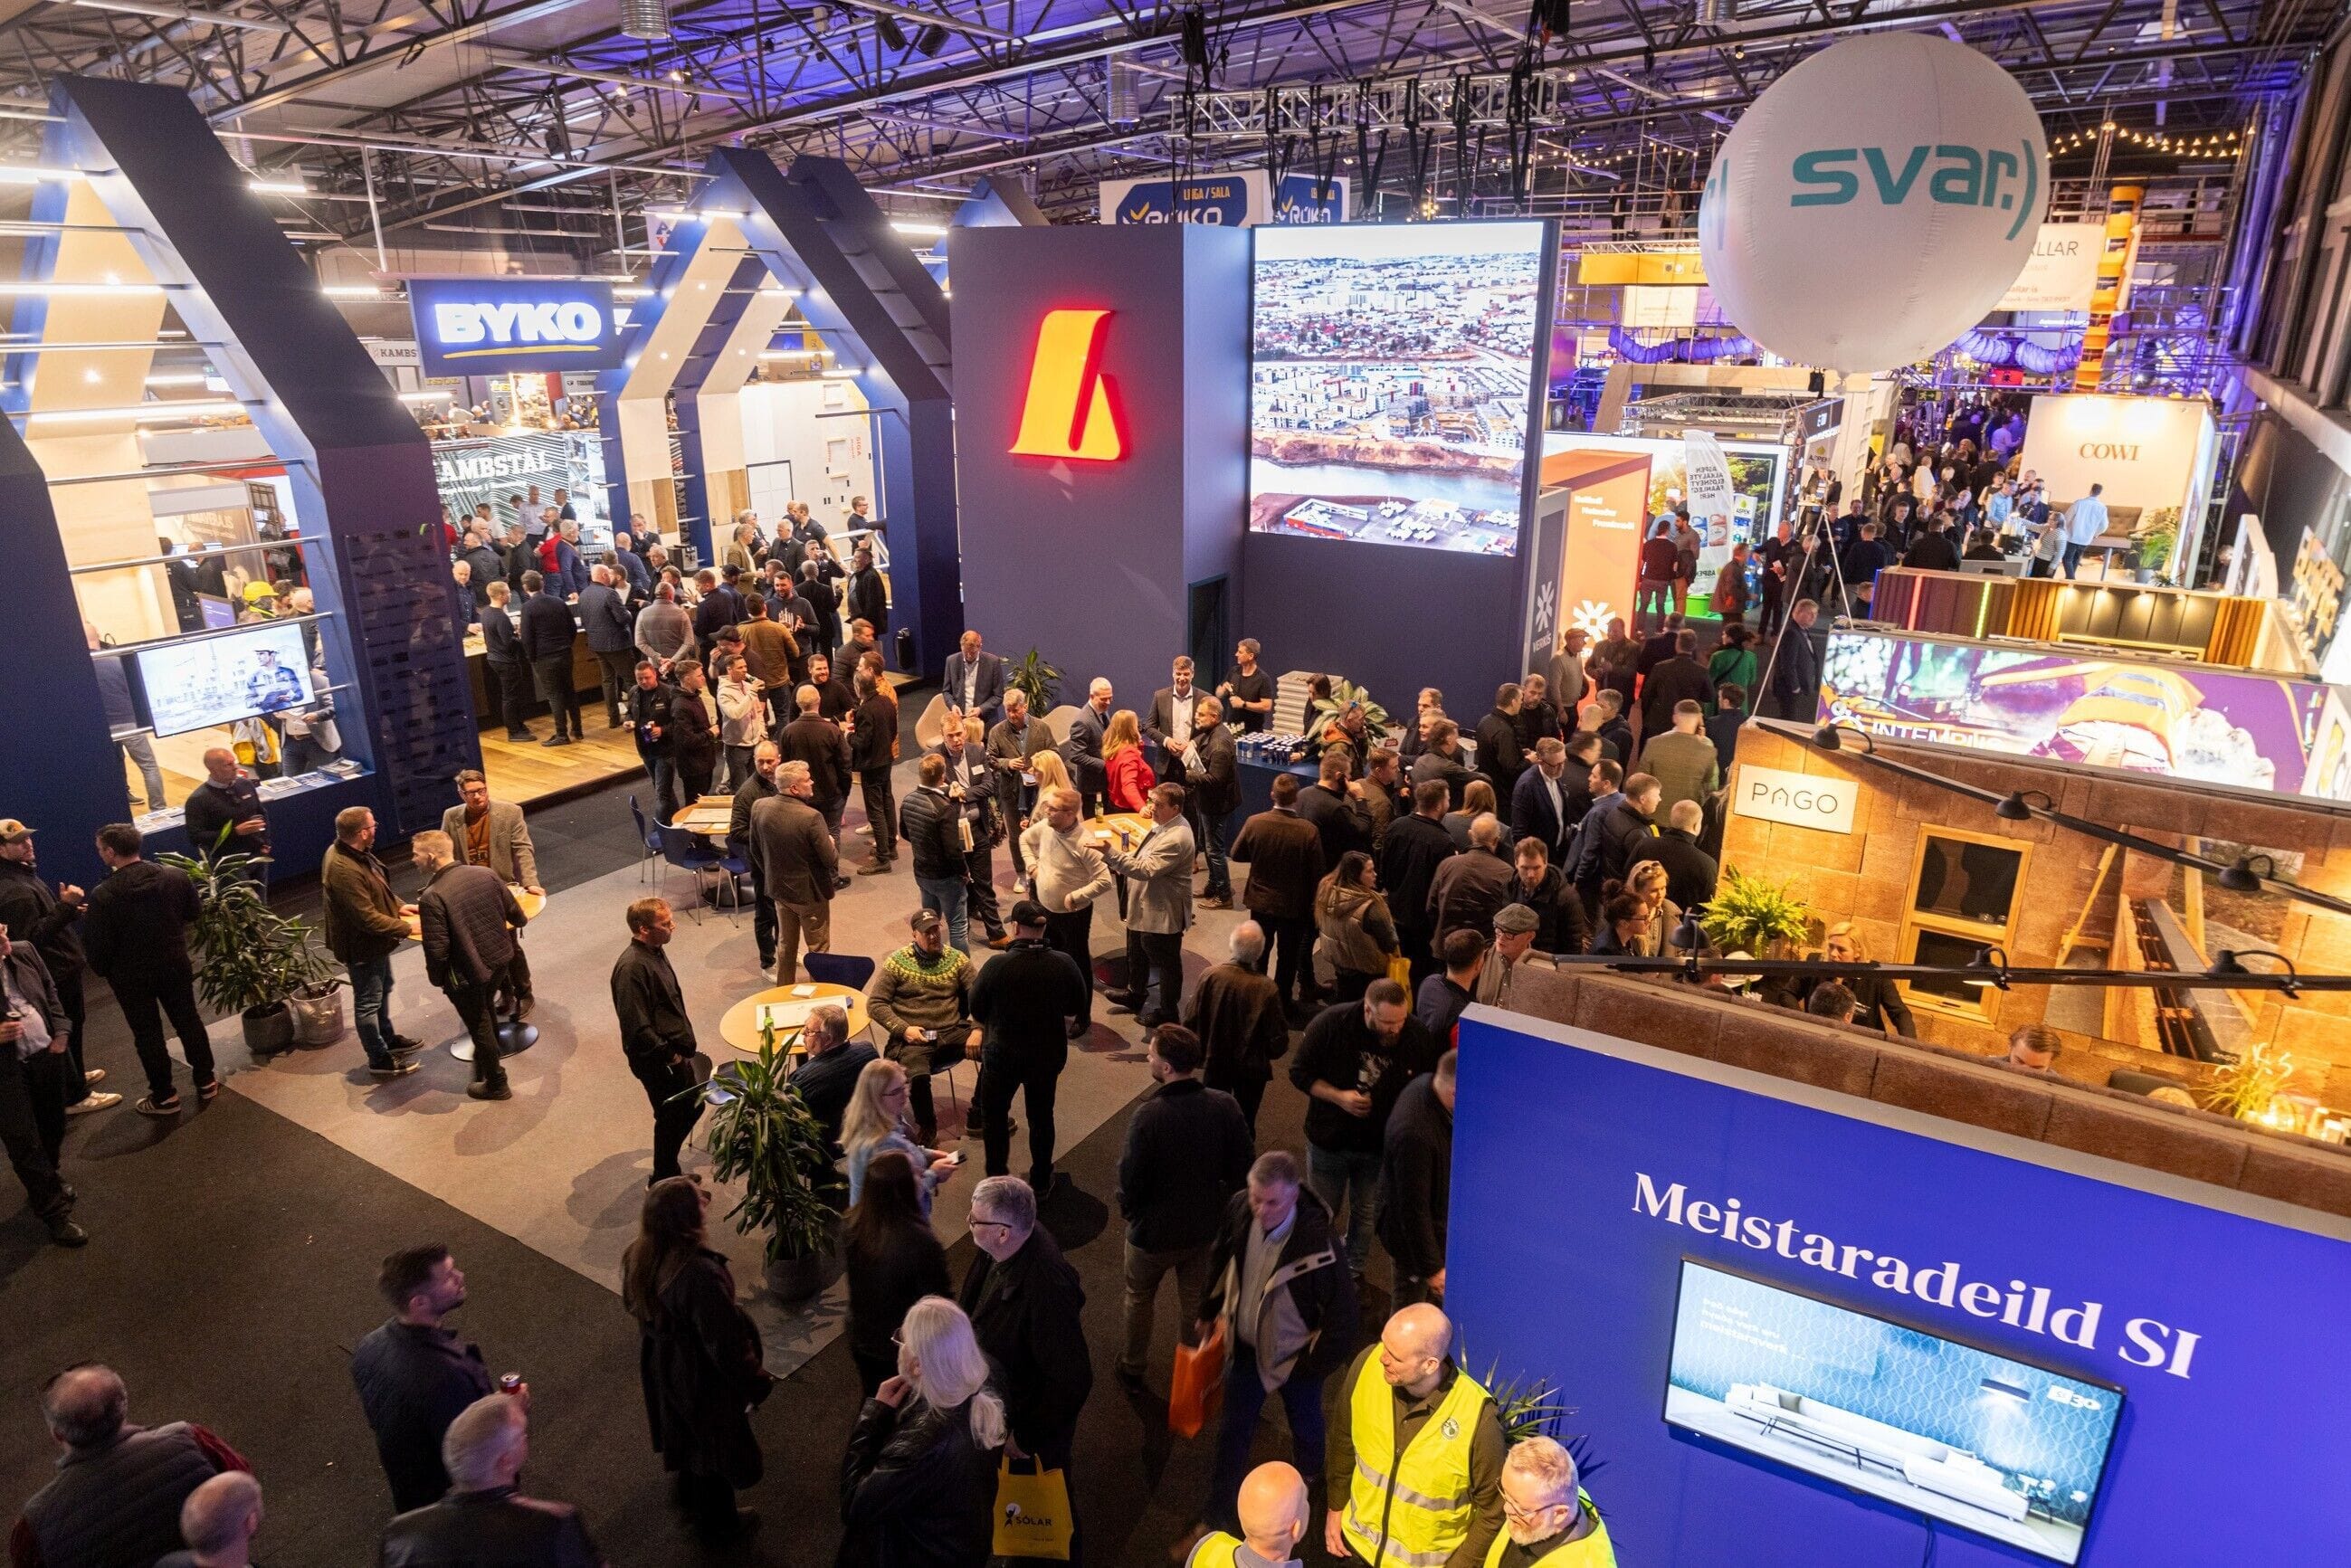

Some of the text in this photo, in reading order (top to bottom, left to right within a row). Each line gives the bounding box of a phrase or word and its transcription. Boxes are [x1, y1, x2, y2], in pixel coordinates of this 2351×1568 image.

[434, 301, 603, 344] BYKO
[433, 446, 553, 483] AMBSTÁL
[2079, 442, 2141, 462] COWI
[1751, 782, 1838, 814] PAGO
[1631, 1172, 2203, 1381] Meistaradeild SI
[1015, 1515, 1052, 1526] SÓLAR
